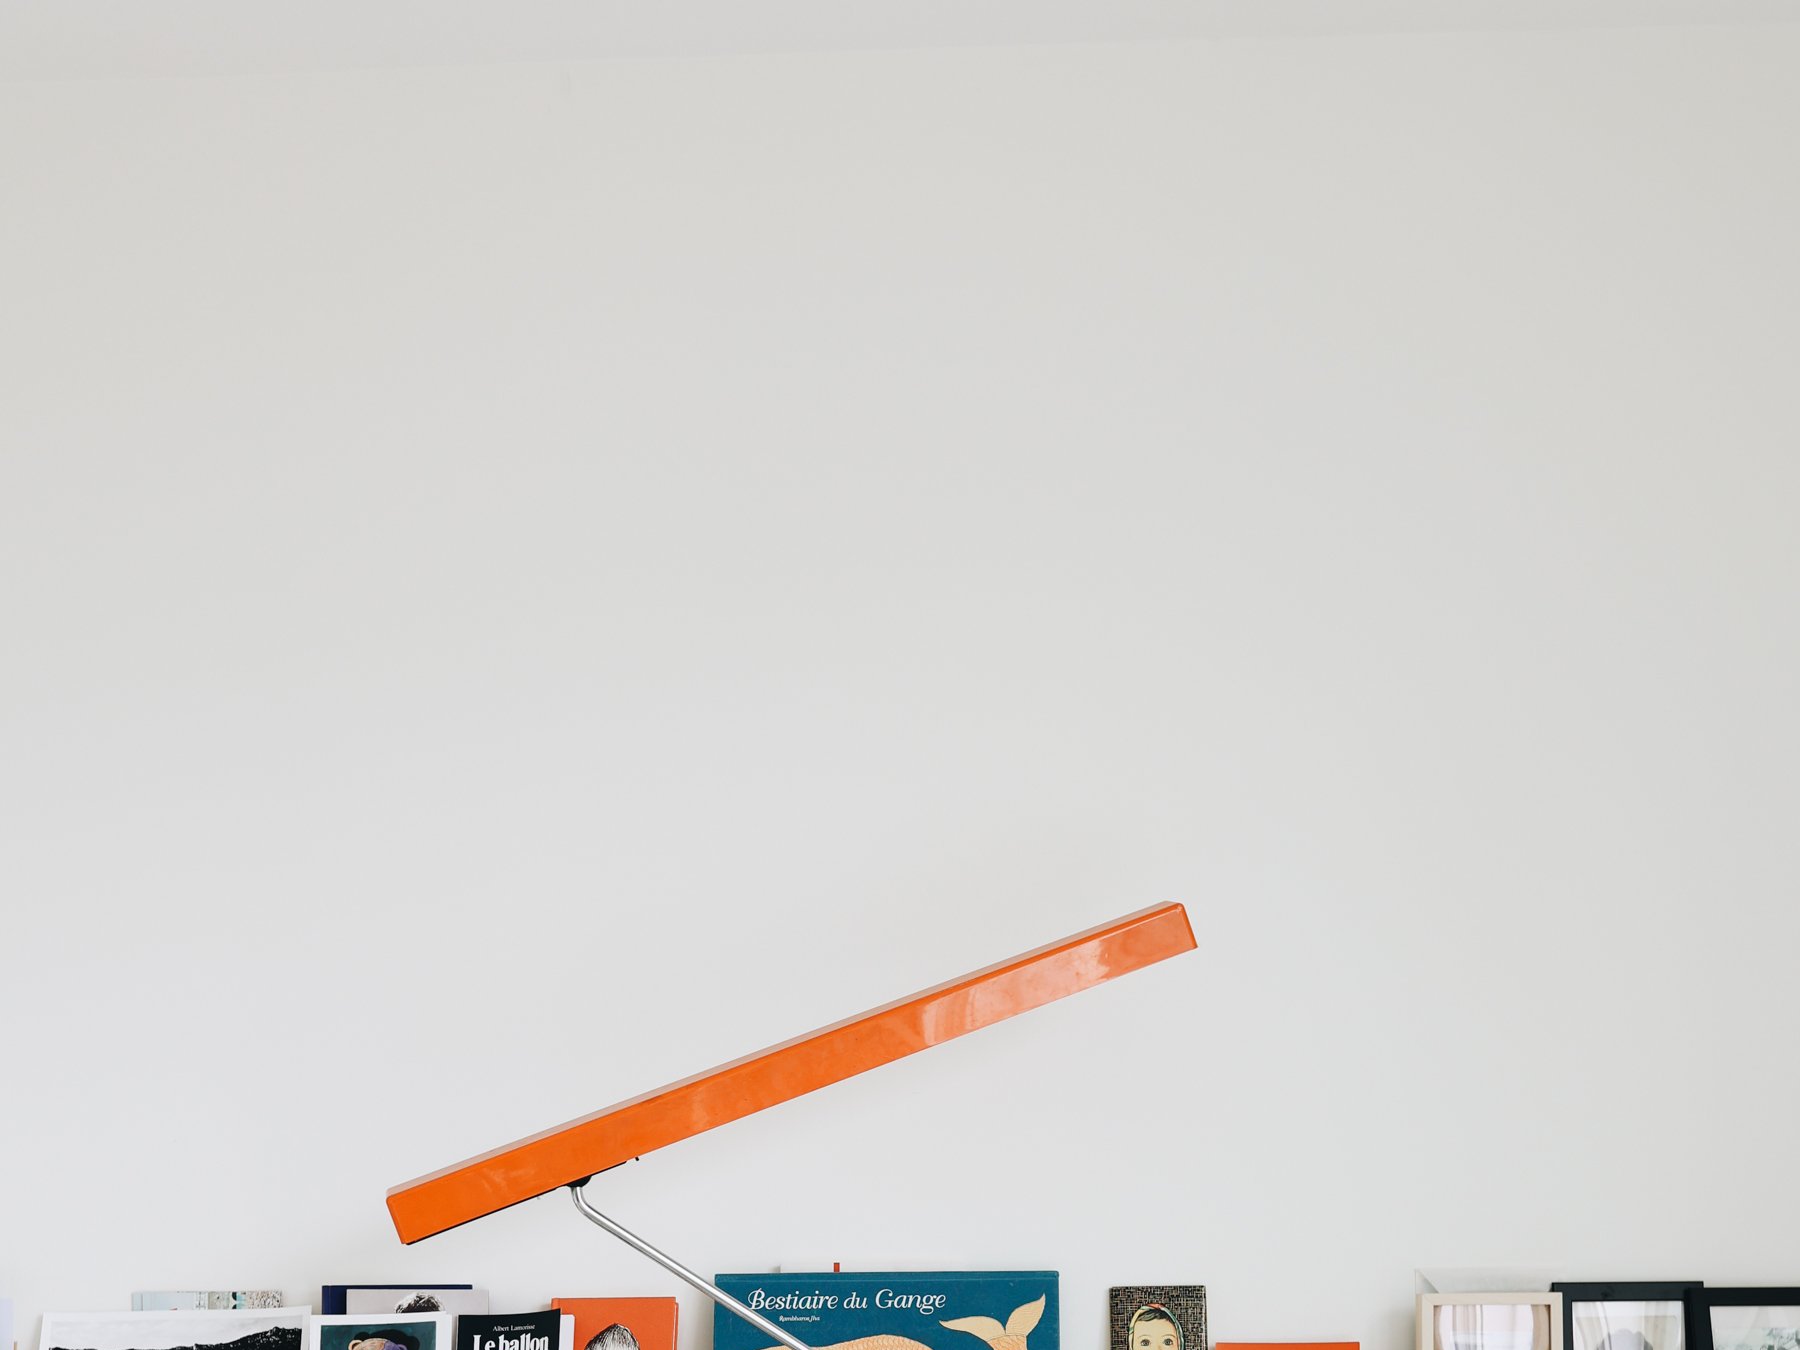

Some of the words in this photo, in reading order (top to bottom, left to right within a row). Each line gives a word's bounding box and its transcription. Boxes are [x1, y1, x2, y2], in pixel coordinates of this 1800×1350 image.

[748, 1287, 839, 1310] Bestiaire
[843, 1292, 868, 1309] du
[875, 1288, 946, 1314] Gange
